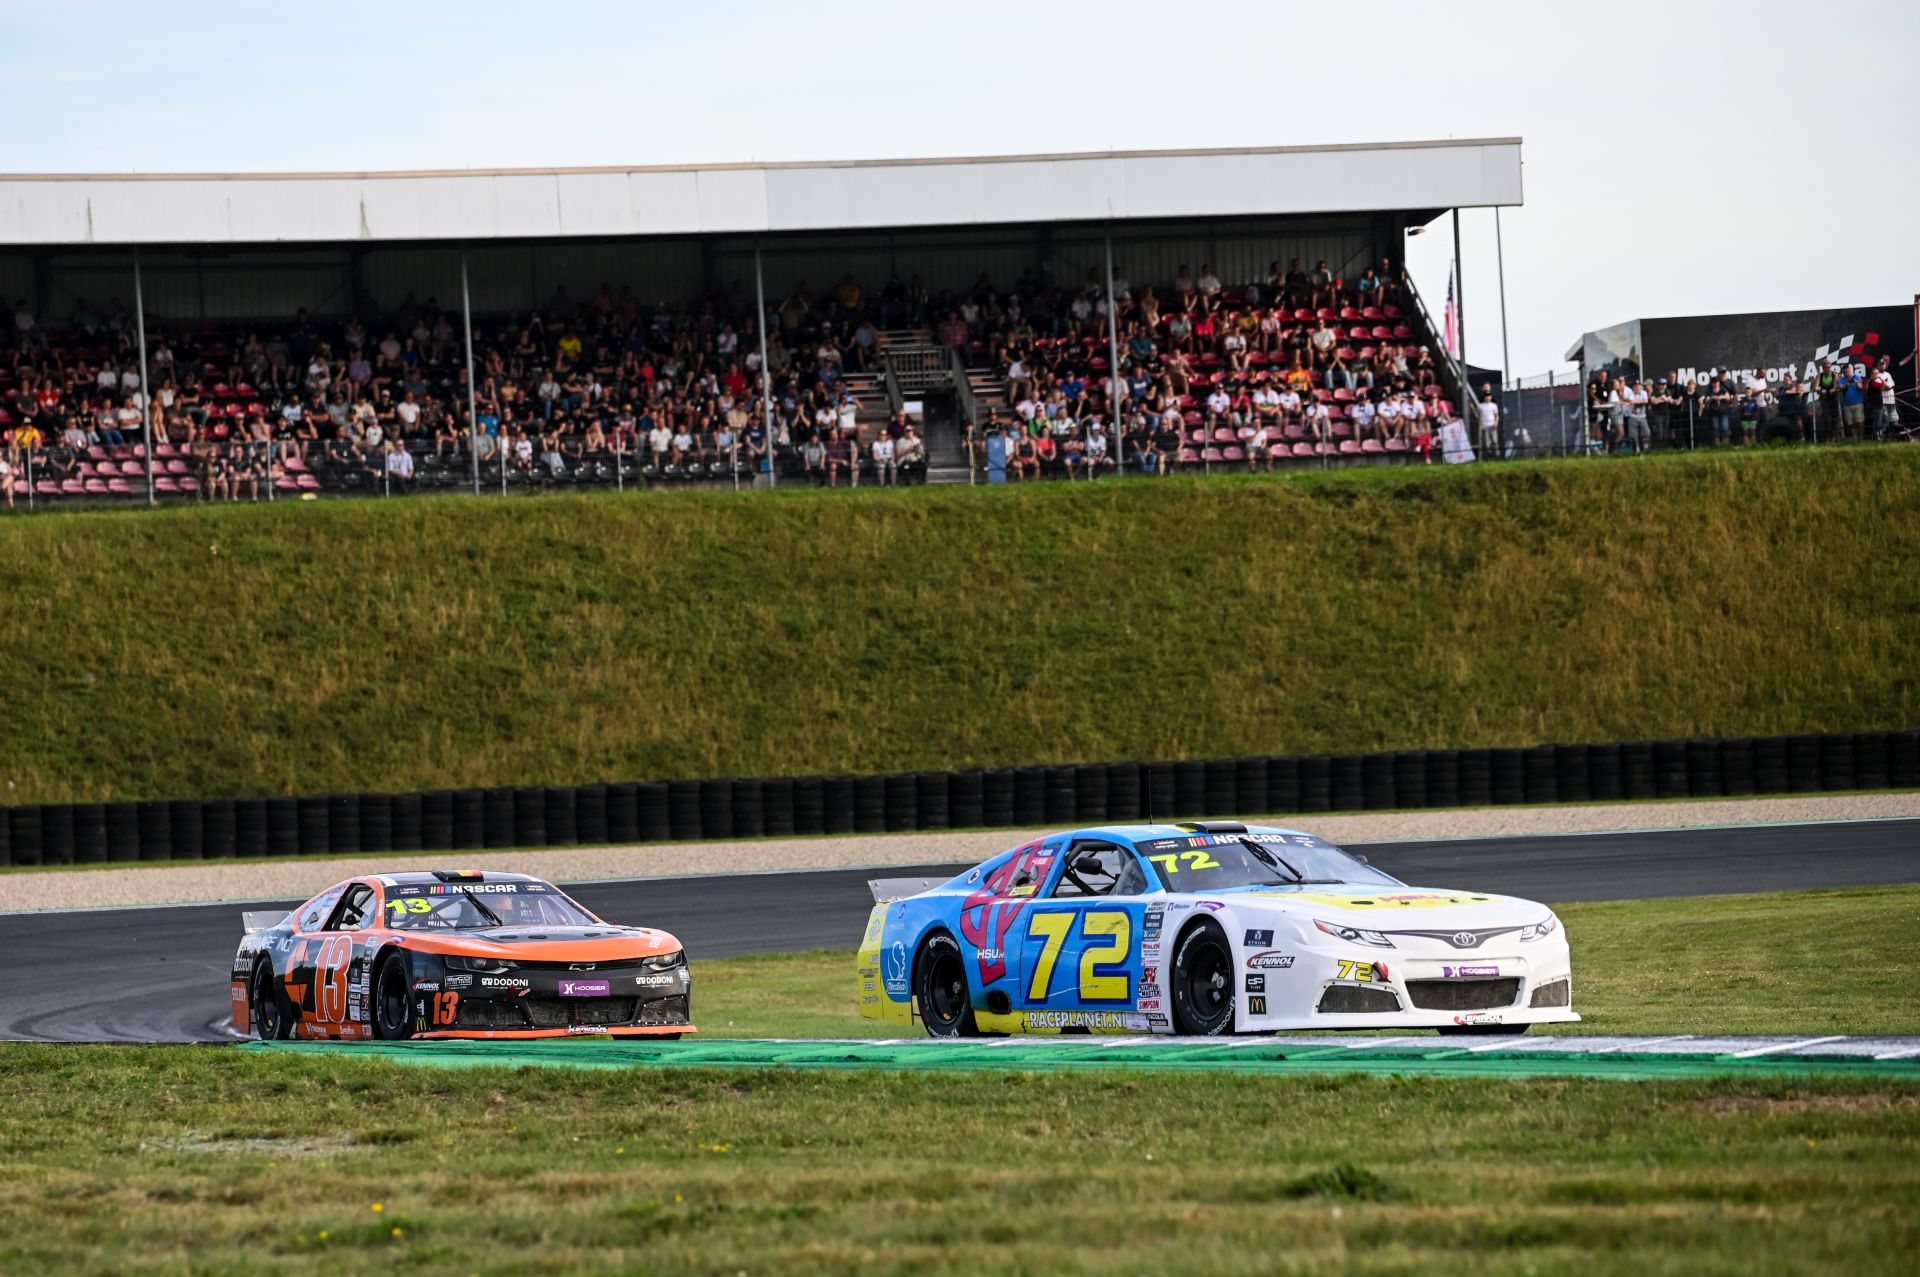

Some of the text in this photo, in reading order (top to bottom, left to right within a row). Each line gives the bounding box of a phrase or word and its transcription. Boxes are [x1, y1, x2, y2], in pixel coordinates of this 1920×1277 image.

[1677, 363, 1798, 387] Motrsort
[1214, 834, 1287, 845] NASCAR
[1148, 851, 1221, 873] 72
[452, 884, 517, 894] NASCAR
[386, 897, 432, 915] 13
[1027, 908, 1131, 1001] 72
[1250, 956, 1292, 966] KENNOL
[1337, 959, 1374, 982] 72
[315, 935, 352, 1024] 13
[416, 982, 440, 990] KENNOL
[494, 978, 529, 987] DODONI
[646, 976, 674, 985] DODONI
[433, 991, 458, 1025] 13
[1139, 1000, 1160, 1009] SIMPSON
